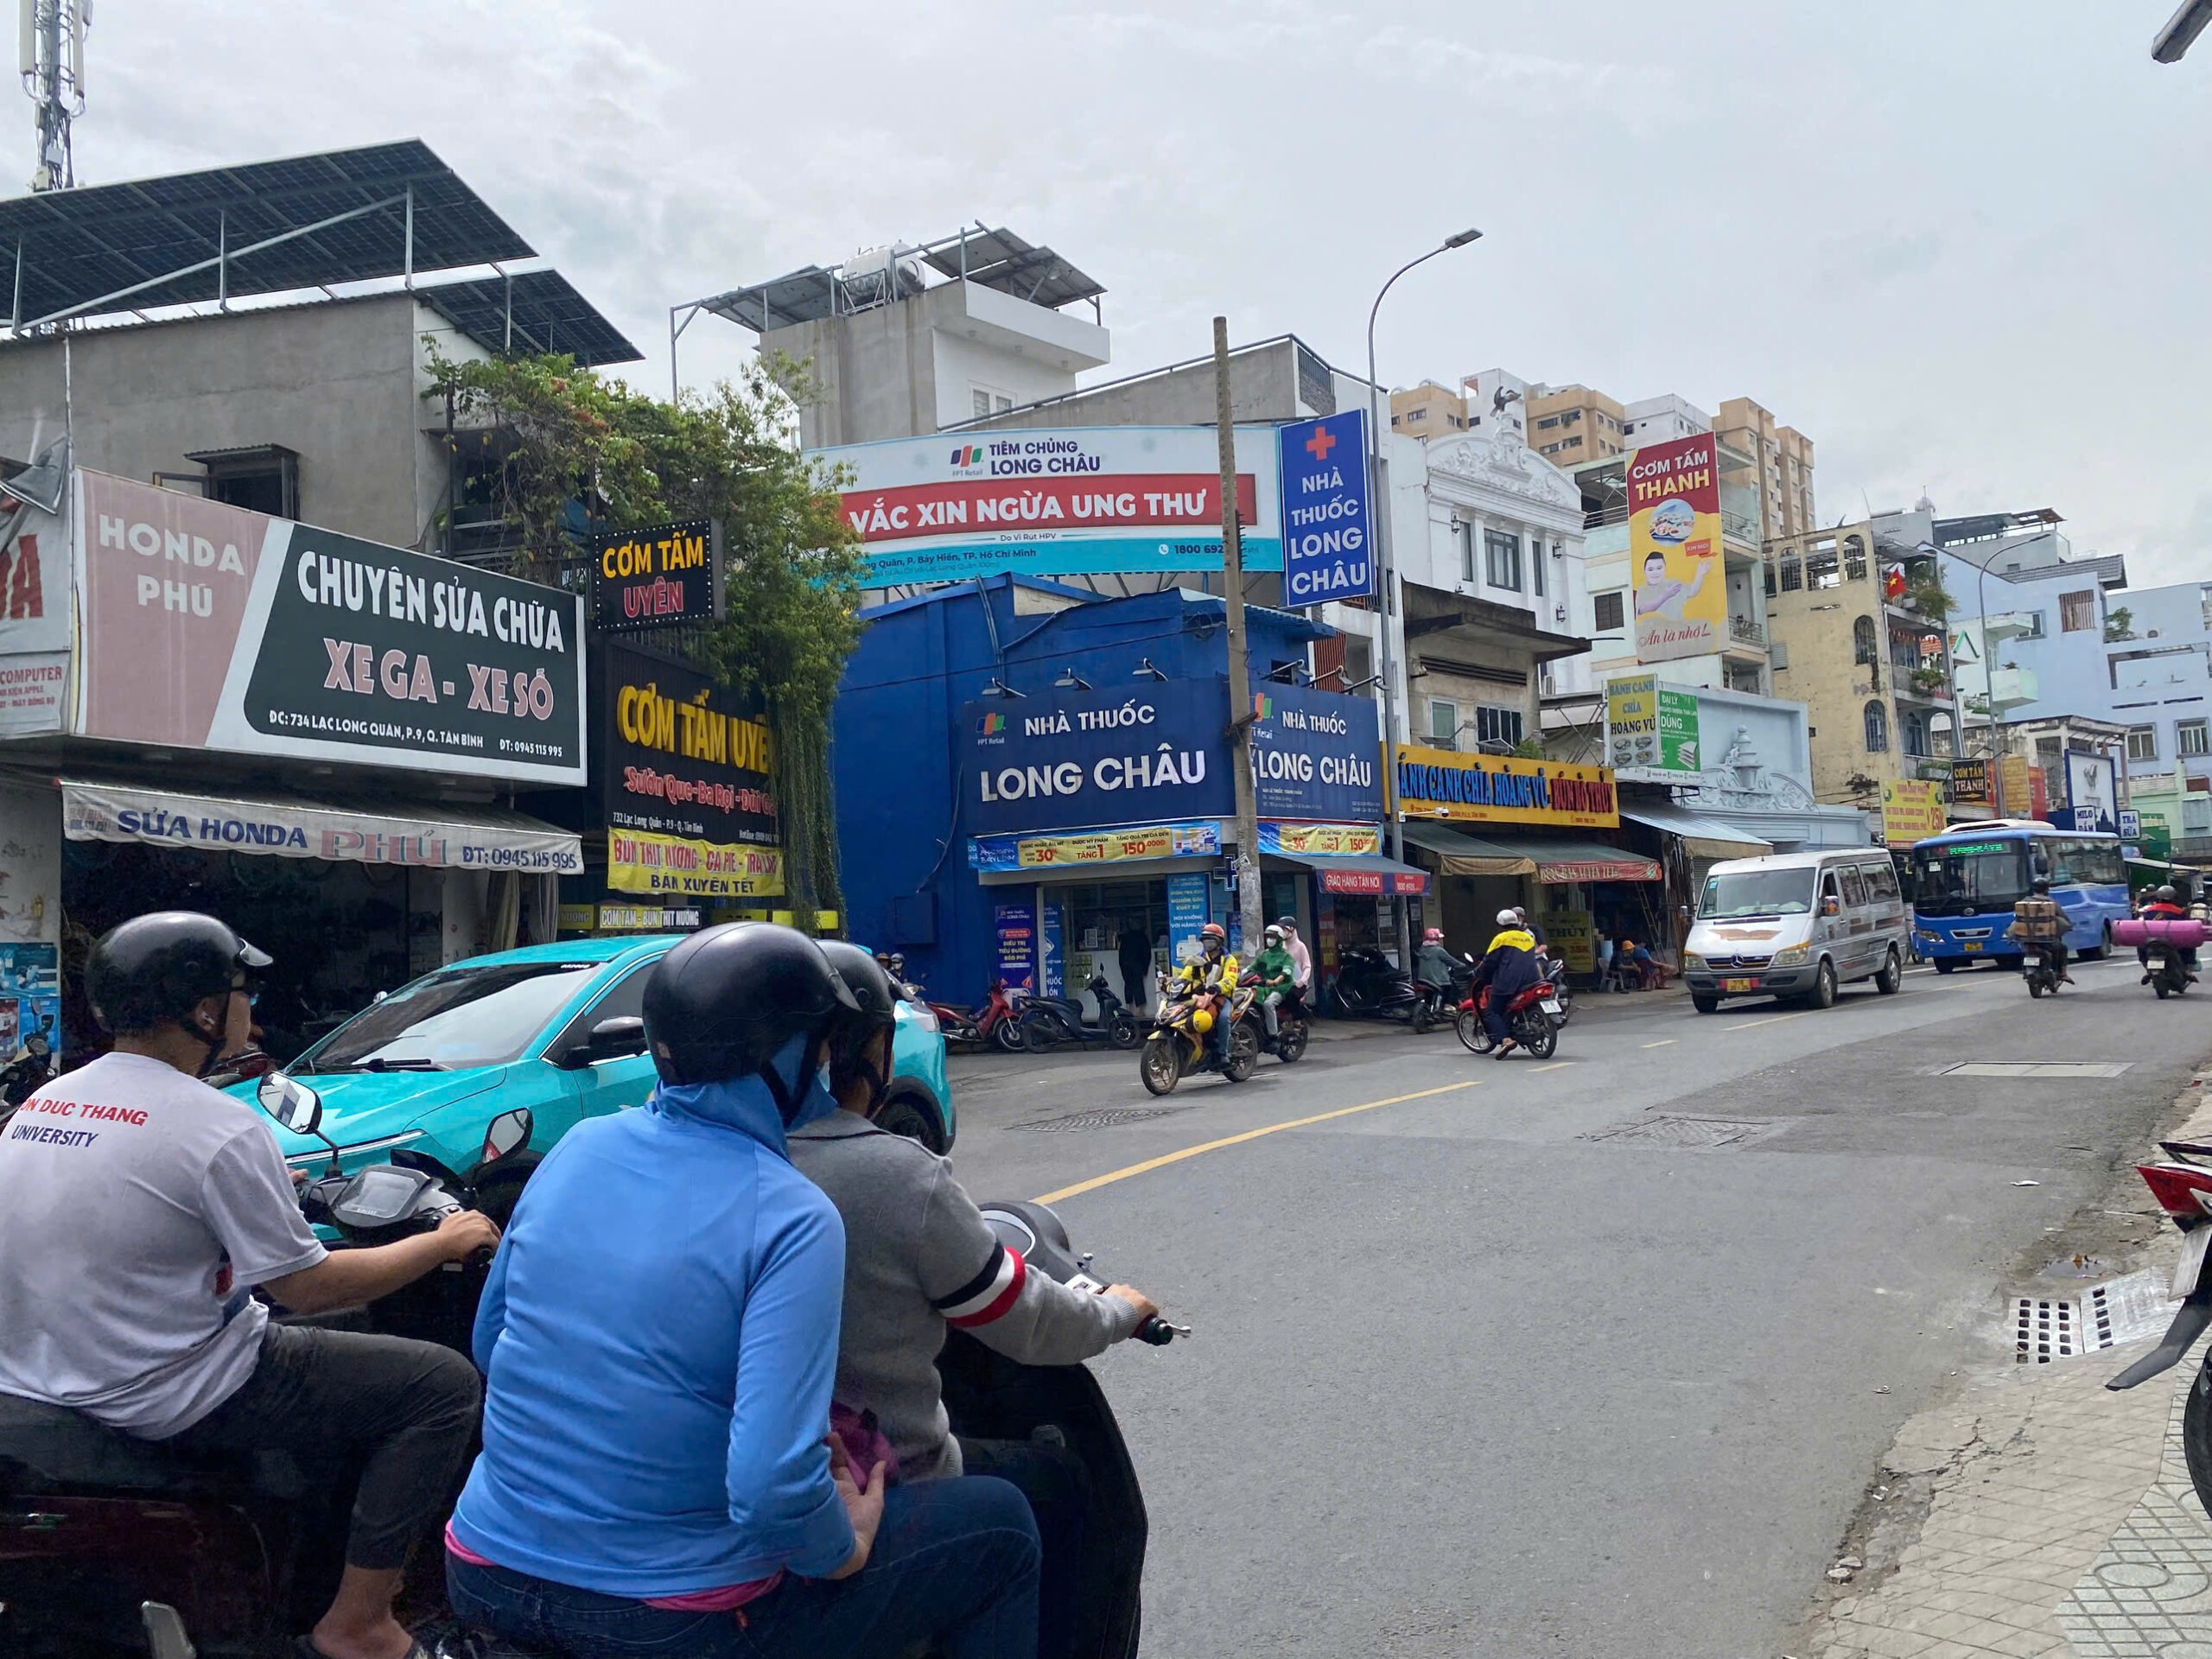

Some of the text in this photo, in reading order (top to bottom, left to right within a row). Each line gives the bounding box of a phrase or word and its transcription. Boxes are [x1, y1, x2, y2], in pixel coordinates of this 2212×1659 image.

[989, 437, 1078, 455] TIÊM CHỦNG
[991, 453, 1101, 475] LONG CHÂU
[1302, 466, 1344, 493] NHÀ
[1632, 448, 1709, 480] CƠM TẤM
[1636, 468, 1710, 501] THANH
[849, 488, 1207, 533] VẮC XIN NGỪA UNG THƯ
[1291, 493, 1359, 526] THUỐC
[99, 513, 245, 576] HONDA
[603, 530, 703, 578] CƠM TẤM
[1013, 547, 1037, 558] Minh
[1174, 544, 1224, 554] 1800 692
[1290, 527, 1363, 560] LONG
[1292, 559, 1366, 594] CHÂU
[297, 550, 565, 653] CHUYÊN SỬA CHỮA
[624, 575, 683, 618] UYÊN
[322, 637, 375, 695] XE
[380, 649, 438, 704] GA
[467, 664, 509, 715] XE
[513, 667, 555, 721] SỐ
[269, 709, 289, 726] ĐC:
[290, 713, 310, 728] 734
[335, 719, 367, 734] LONG
[514, 741, 534, 754] 0945
[535, 744, 547, 756] 115
[548, 746, 563, 758] 995
[617, 682, 774, 775] CƠM TẤM UYÊ
[1025, 698, 1156, 736] NHÀ THUỐC
[1282, 709, 1347, 735] NHÀ THUỐC
[1611, 719, 1641, 734] HOÀNG
[981, 743, 1206, 802] LONG CHÂU
[1258, 750, 1371, 787] LONG CHÂU
[1398, 752, 1427, 799] ÁNH
[1427, 766, 1462, 803] CANH
[1492, 764, 1531, 808] HOÀNG
[624, 766, 664, 798] Sườn
[696, 779, 714, 805] Ba
[715, 783, 734, 814] Rọi
[1955, 779, 1985, 792] THANH
[634, 813, 647, 827] Long
[2076, 810, 2094, 819] MILO
[118, 806, 192, 839] SỬA
[200, 817, 308, 849] HONDA
[462, 846, 489, 863] ĐT:
[491, 849, 529, 867] 0945
[531, 852, 550, 868] 115
[552, 852, 579, 870] 995
[651, 872, 754, 893] BÁN XUYÊN TẾT
[40, 1099, 149, 1127] DUC THANG
[11, 1124, 99, 1147] UNIVERSITY
